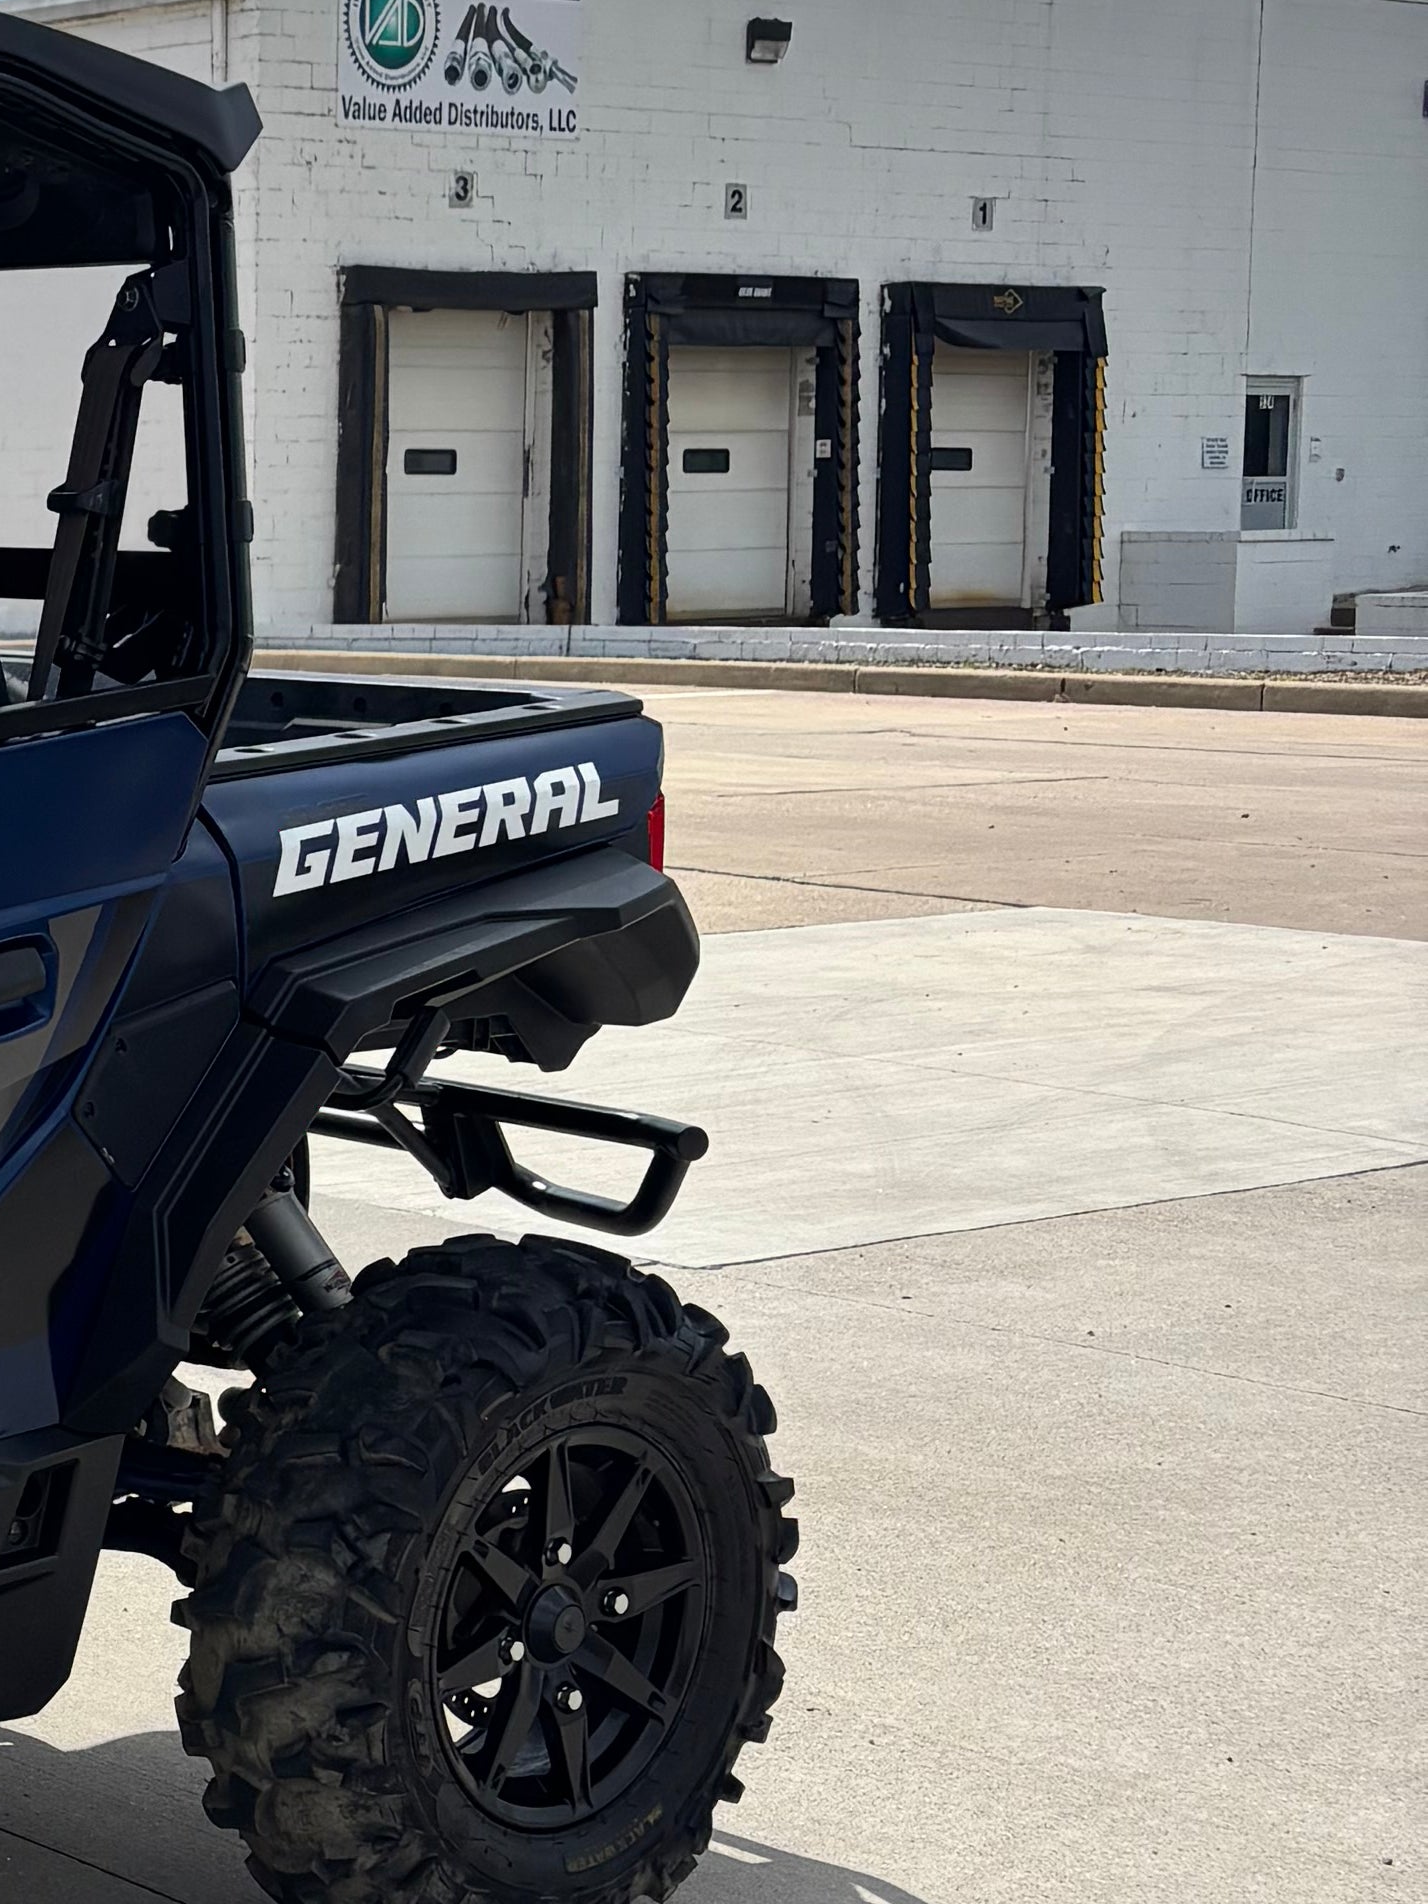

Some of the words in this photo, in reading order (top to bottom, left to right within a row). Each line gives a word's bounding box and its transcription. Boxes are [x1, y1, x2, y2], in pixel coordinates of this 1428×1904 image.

[341, 94, 387, 122] Value
[391, 98, 443, 125] Added
[447, 102, 544, 136] Distributors,
[548, 107, 577, 133] LLC
[455, 175, 469, 201] 3
[731, 189, 743, 213] 2
[979, 202, 987, 225] 1
[1246, 488, 1284, 503] OFFICE
[273, 762, 620, 897] GENERAL
